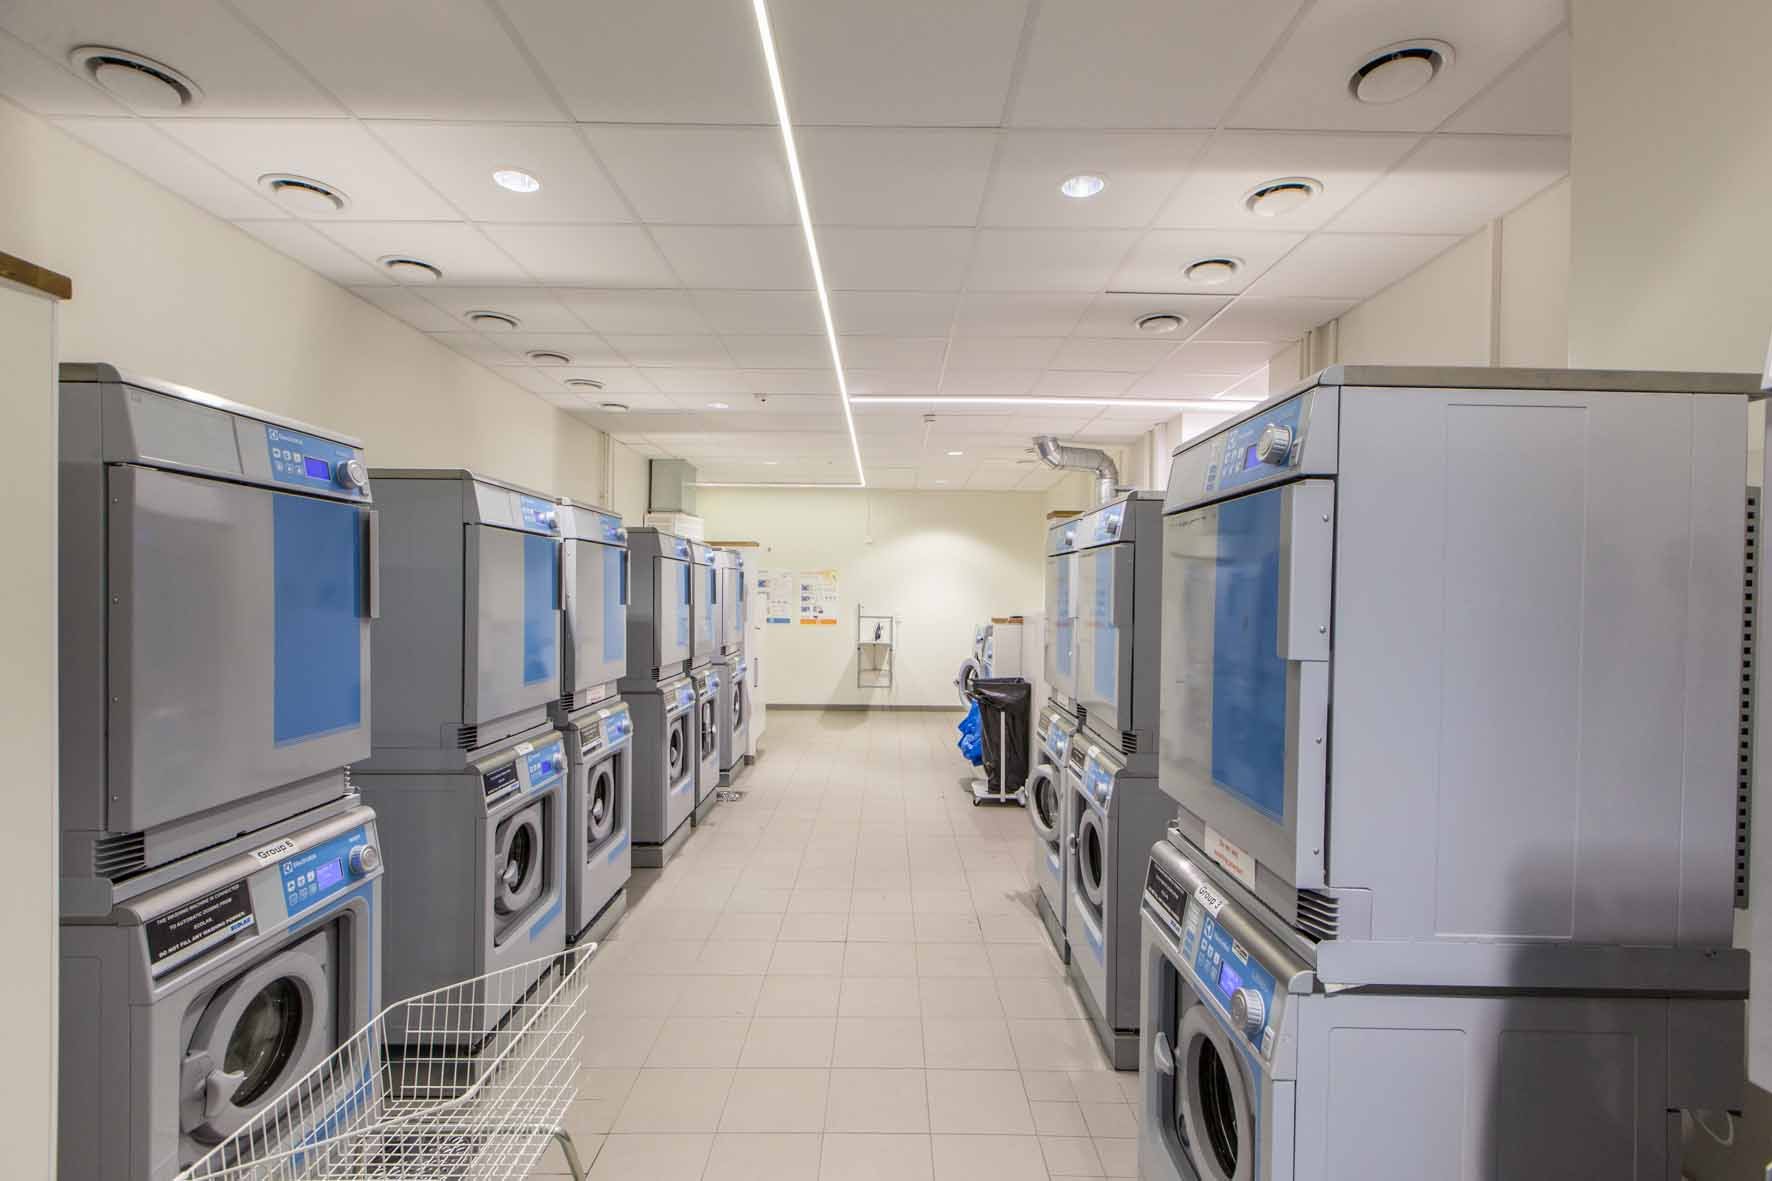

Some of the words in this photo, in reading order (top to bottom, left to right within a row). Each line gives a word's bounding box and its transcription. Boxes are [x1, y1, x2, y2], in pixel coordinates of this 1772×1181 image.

[257, 844, 287, 860] Group
[286, 840, 295, 848] 5
[1199, 886, 1217, 905] Group
